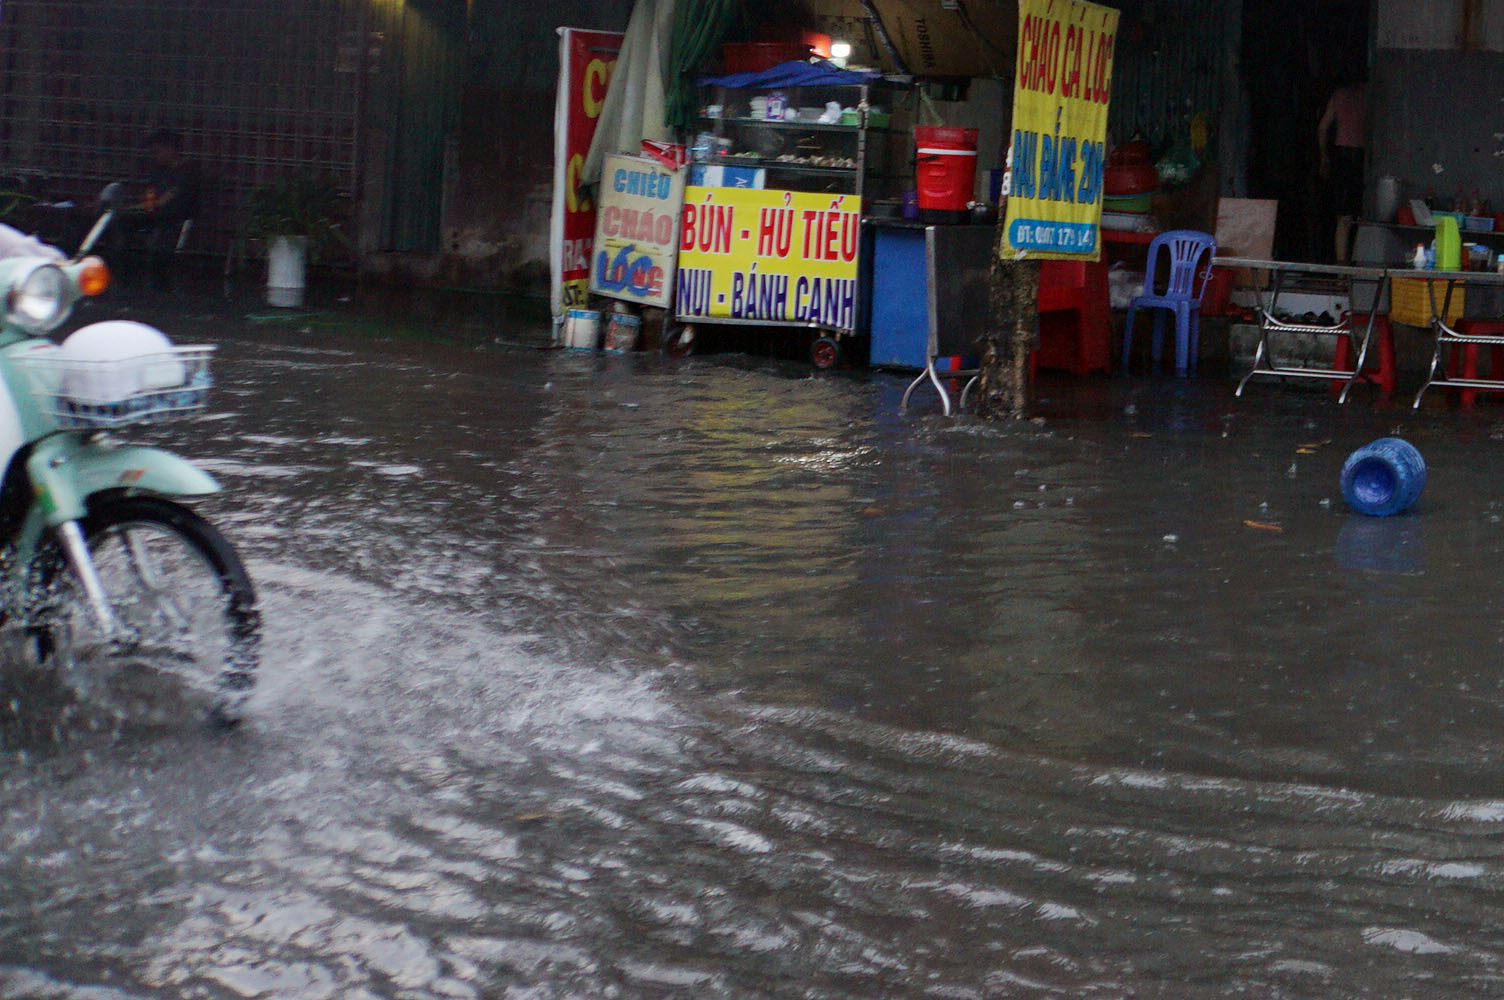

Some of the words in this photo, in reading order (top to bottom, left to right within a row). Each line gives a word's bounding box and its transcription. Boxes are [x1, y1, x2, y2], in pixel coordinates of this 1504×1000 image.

[915, 17, 935, 69] TOSHIBA
[1061, 7, 1087, 99] CÁ
[603, 204, 673, 246] CHÁO
[682, 193, 734, 255] BÚN
[757, 191, 795, 259] HỦ
[802, 195, 860, 262] TIẾU
[677, 268, 712, 317] NUI
[731, 261, 788, 322] BÁNH
[794, 275, 856, 330] CANH
